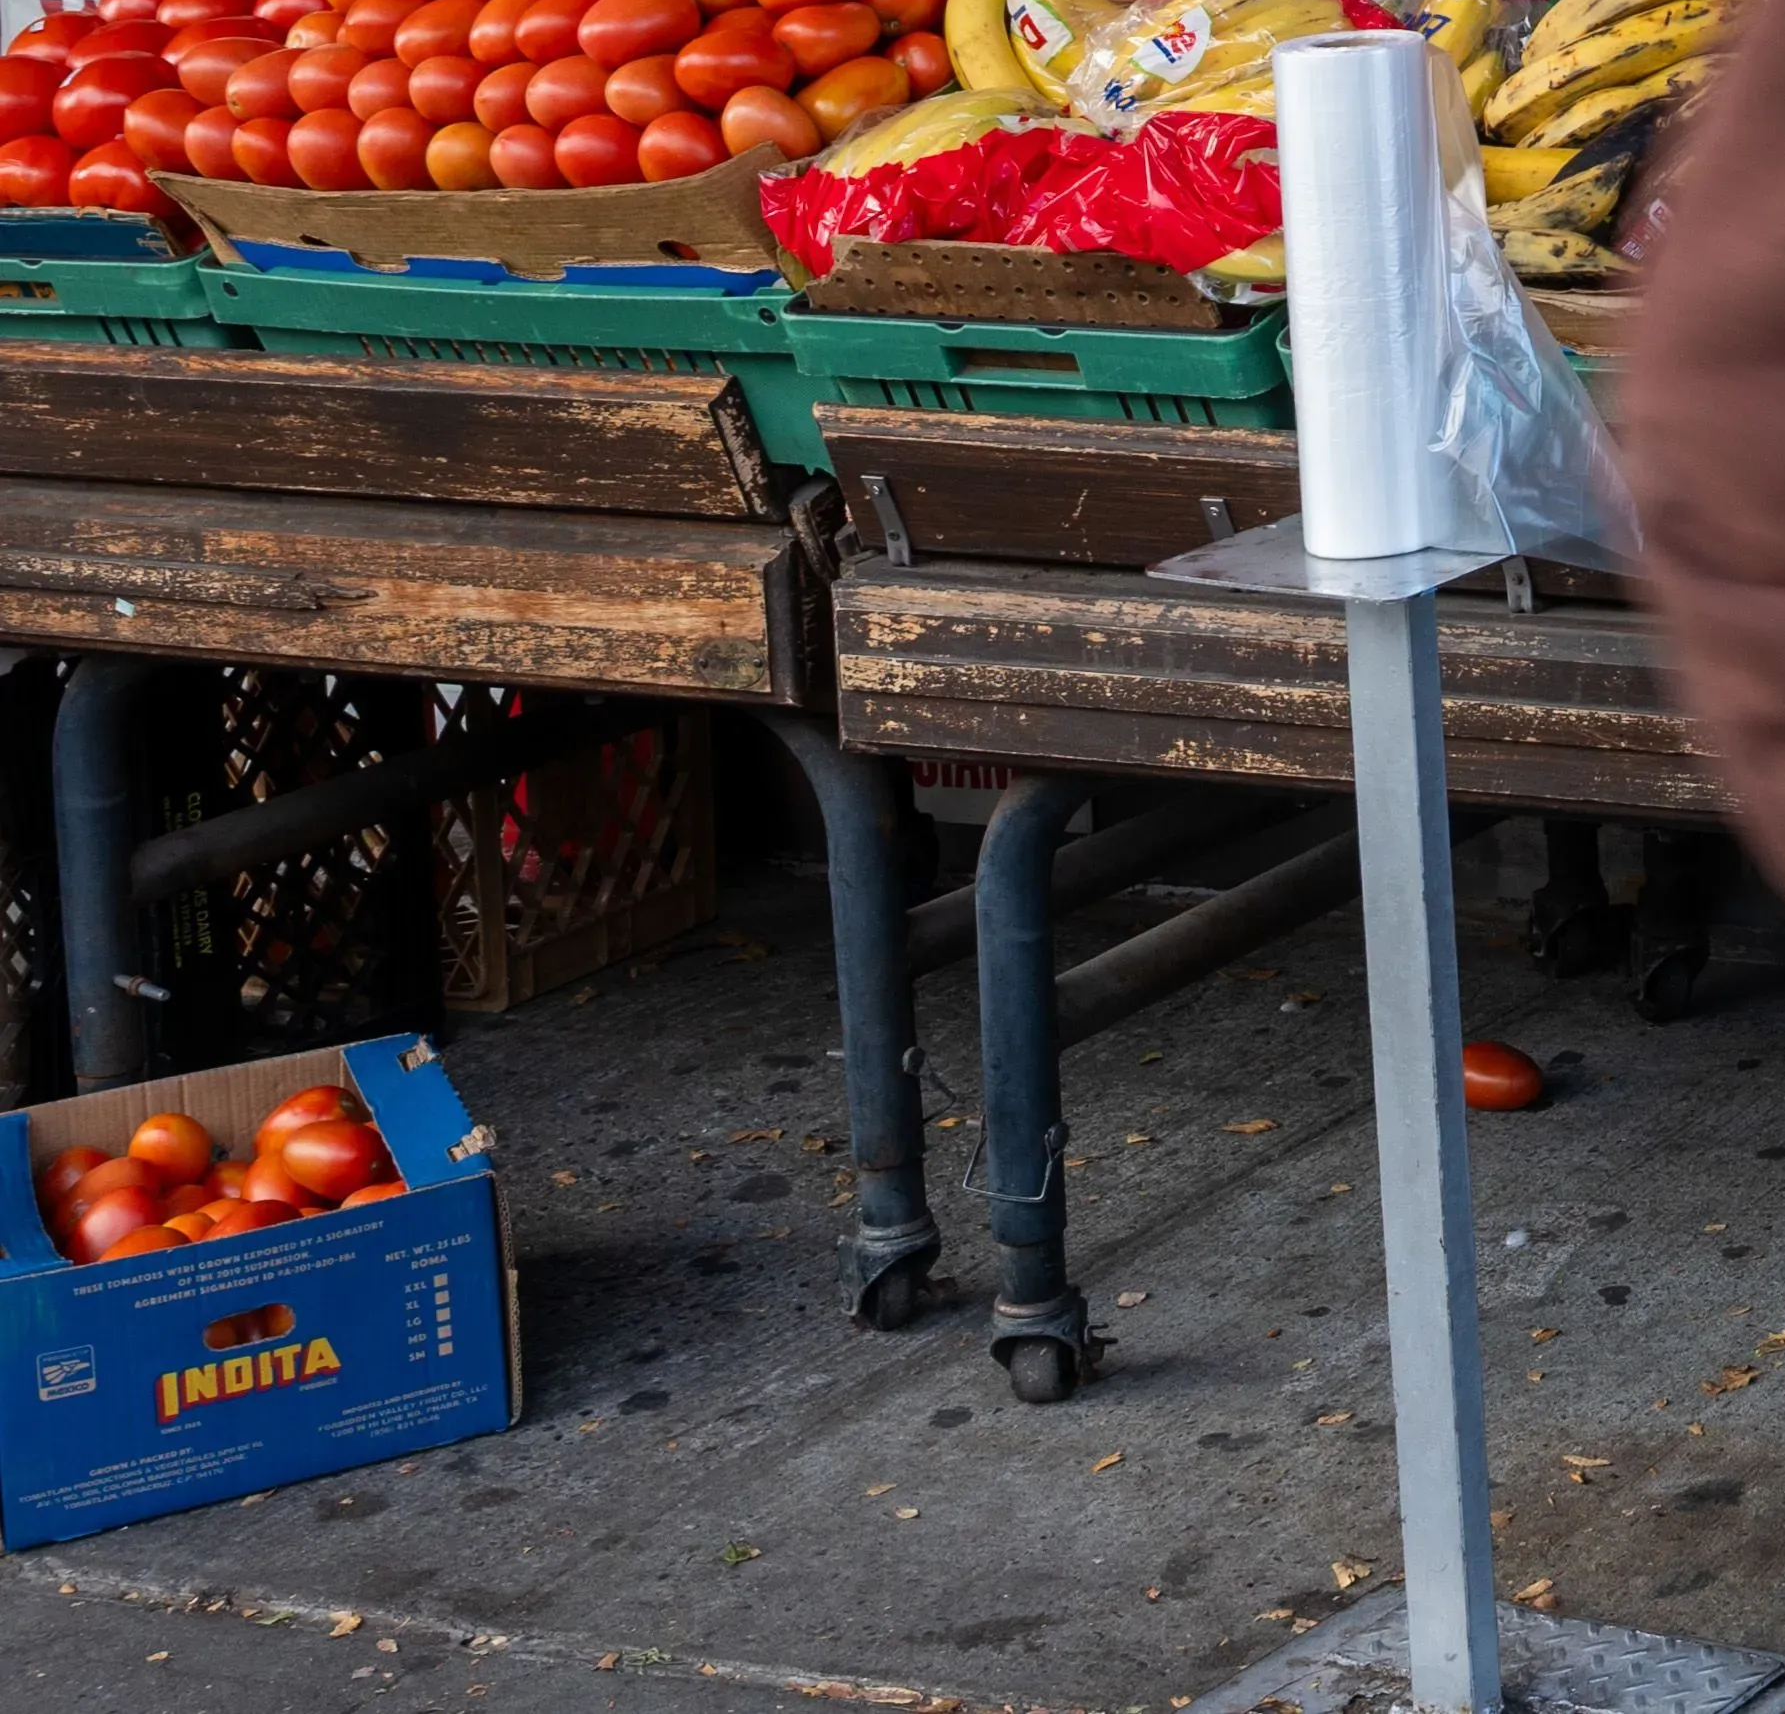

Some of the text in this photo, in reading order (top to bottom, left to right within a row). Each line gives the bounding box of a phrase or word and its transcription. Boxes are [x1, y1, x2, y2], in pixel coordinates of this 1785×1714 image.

[186, 790, 203, 823] CLO
[452, 1234, 472, 1246] LBS
[107, 1271, 164, 1291] TOMATOES
[199, 1252, 241, 1270] GROWN
[244, 1242, 297, 1266] EXPORTED
[301, 1237, 313, 1248] BY
[326, 1221, 385, 1242] SIGNATORY
[411, 1254, 448, 1270] ROMA
[178, 1277, 192, 1287] OF
[217, 1267, 242, 1279] 2019
[135, 1271, 274, 1309] AGREEMENT SIGNATORY ID
[405, 1300, 420, 1311] XL
[406, 1317, 422, 1328] LG
[408, 1333, 427, 1345] MD
[408, 1350, 426, 1363] SM
[158, 1337, 342, 1424] INDITA
[89, 1461, 129, 1477] GROWN
[140, 1452, 178, 1466] PACKED
